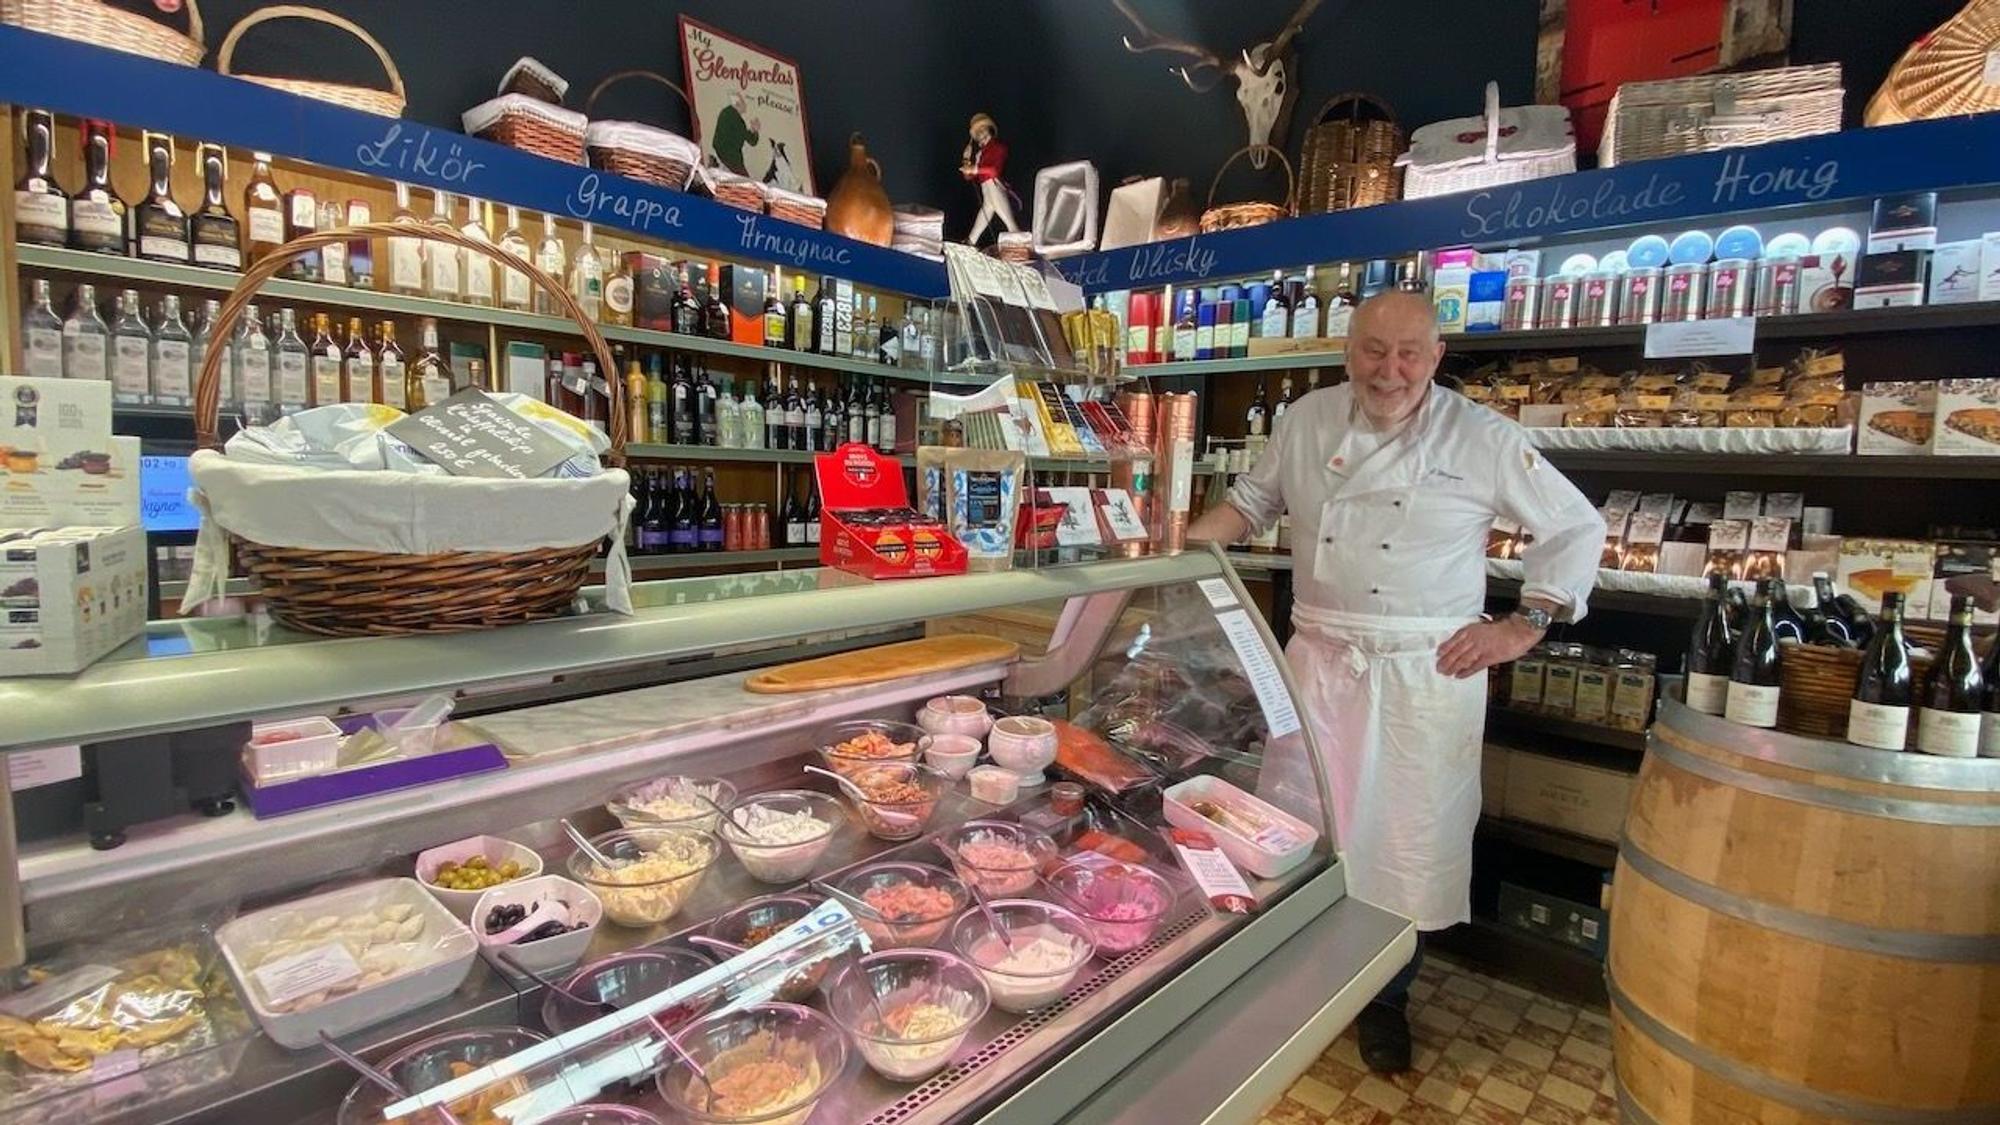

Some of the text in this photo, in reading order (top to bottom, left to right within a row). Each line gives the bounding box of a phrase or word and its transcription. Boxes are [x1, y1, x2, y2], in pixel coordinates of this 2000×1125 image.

[688, 28, 712, 48] My
[693, 48, 794, 90] Glenfarclas
[357, 124, 486, 182] Likör
[566, 174, 683, 230] Grappa
[1460, 154, 1839, 238] Schokolade Honig
[736, 214, 851, 265] Armagnac
[1129, 237, 1217, 280] Whisky
